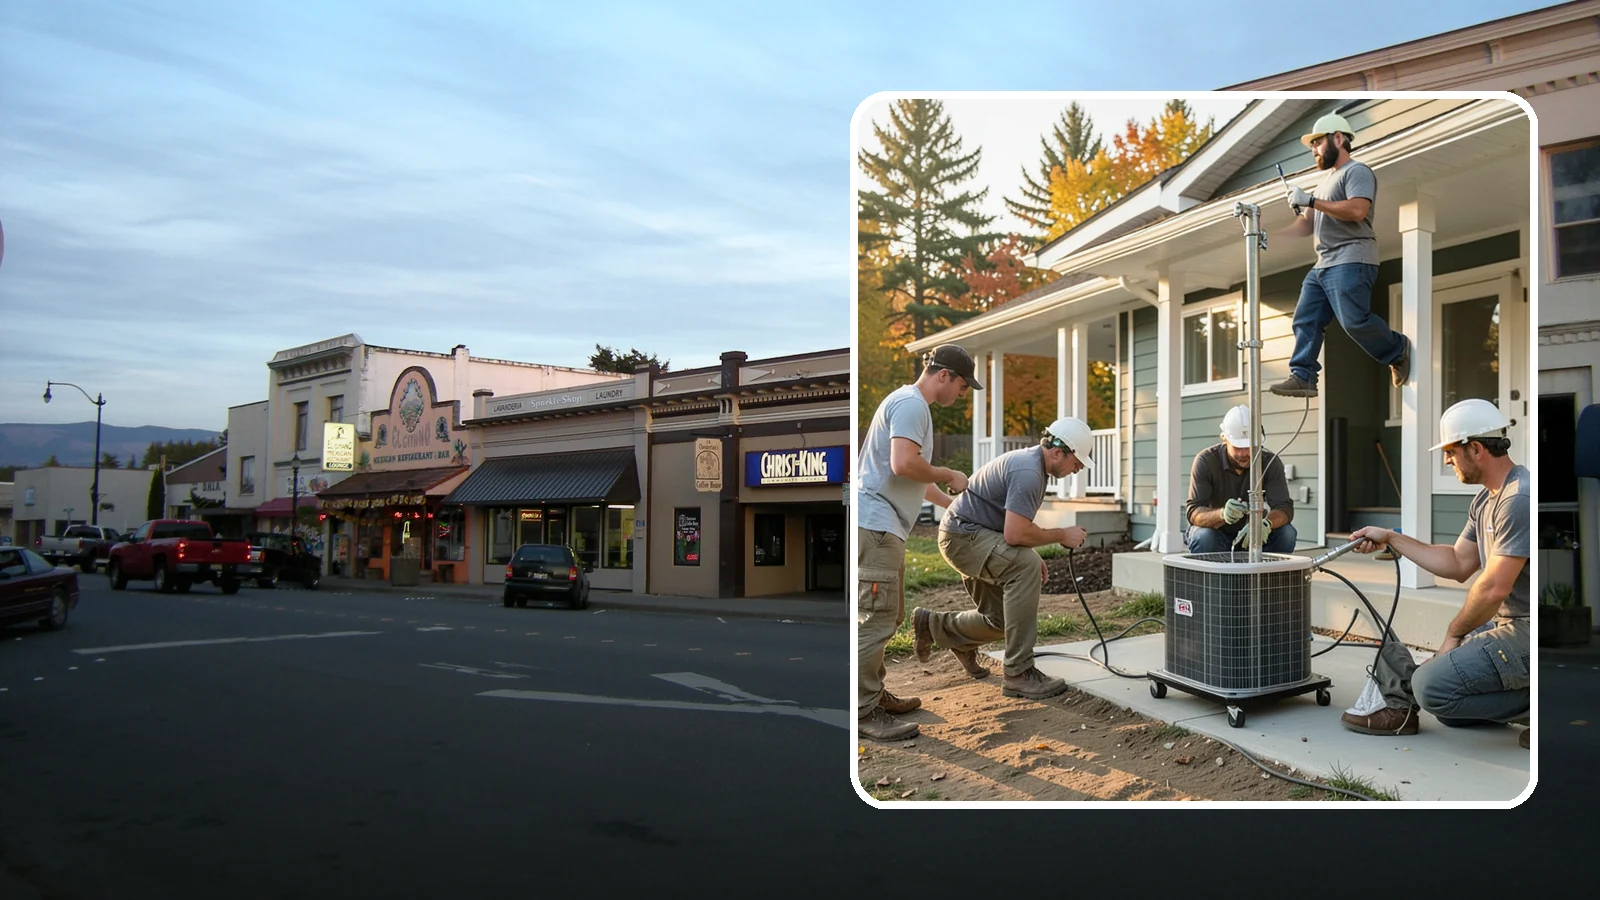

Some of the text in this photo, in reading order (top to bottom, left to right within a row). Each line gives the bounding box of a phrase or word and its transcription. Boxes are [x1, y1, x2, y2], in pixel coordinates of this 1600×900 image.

[531, 394, 583, 408] Sparkle Shop
[595, 388, 624, 400] LAUNDRY
[493, 402, 523, 413] LAVANDERIA
[373, 455, 396, 464] MEXICAN
[397, 451, 434, 463] RESTAURANT
[438, 450, 450, 459] BAR
[761, 450, 827, 478] CHRIST KING
